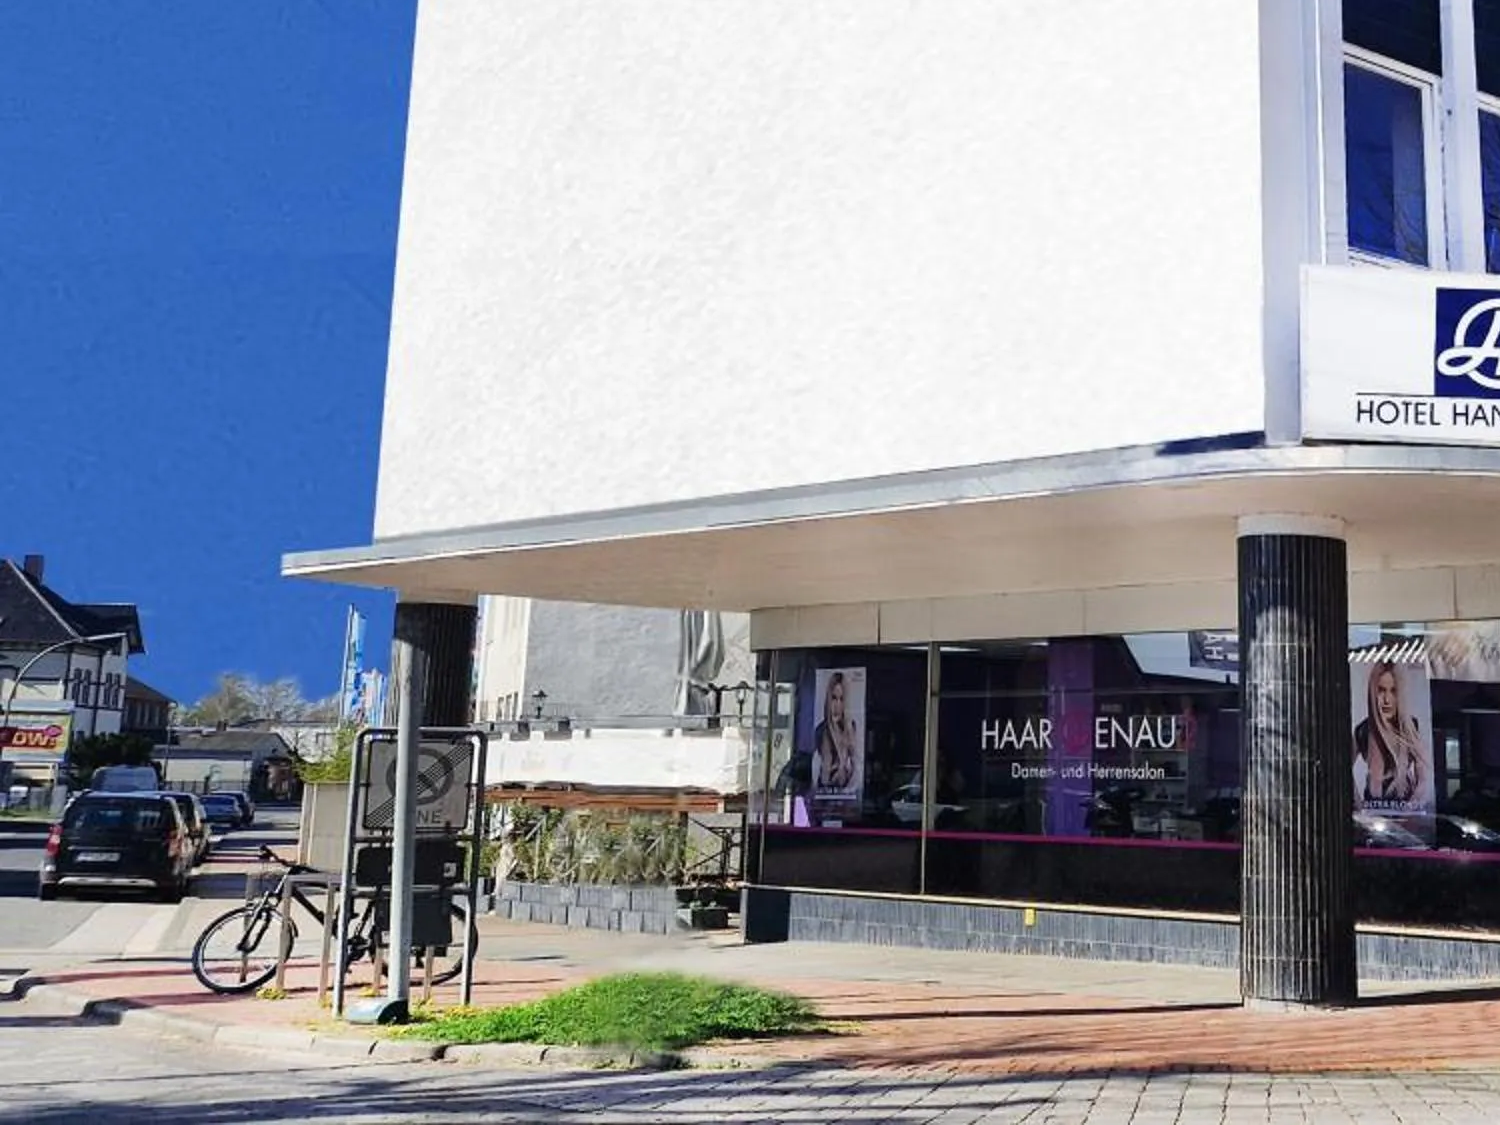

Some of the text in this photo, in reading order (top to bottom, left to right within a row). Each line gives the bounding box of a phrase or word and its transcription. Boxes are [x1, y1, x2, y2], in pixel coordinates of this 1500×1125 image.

[1355, 399, 1441, 426] HOTEL
[1011, 759, 1166, 780] Damen- und Herrensalon
